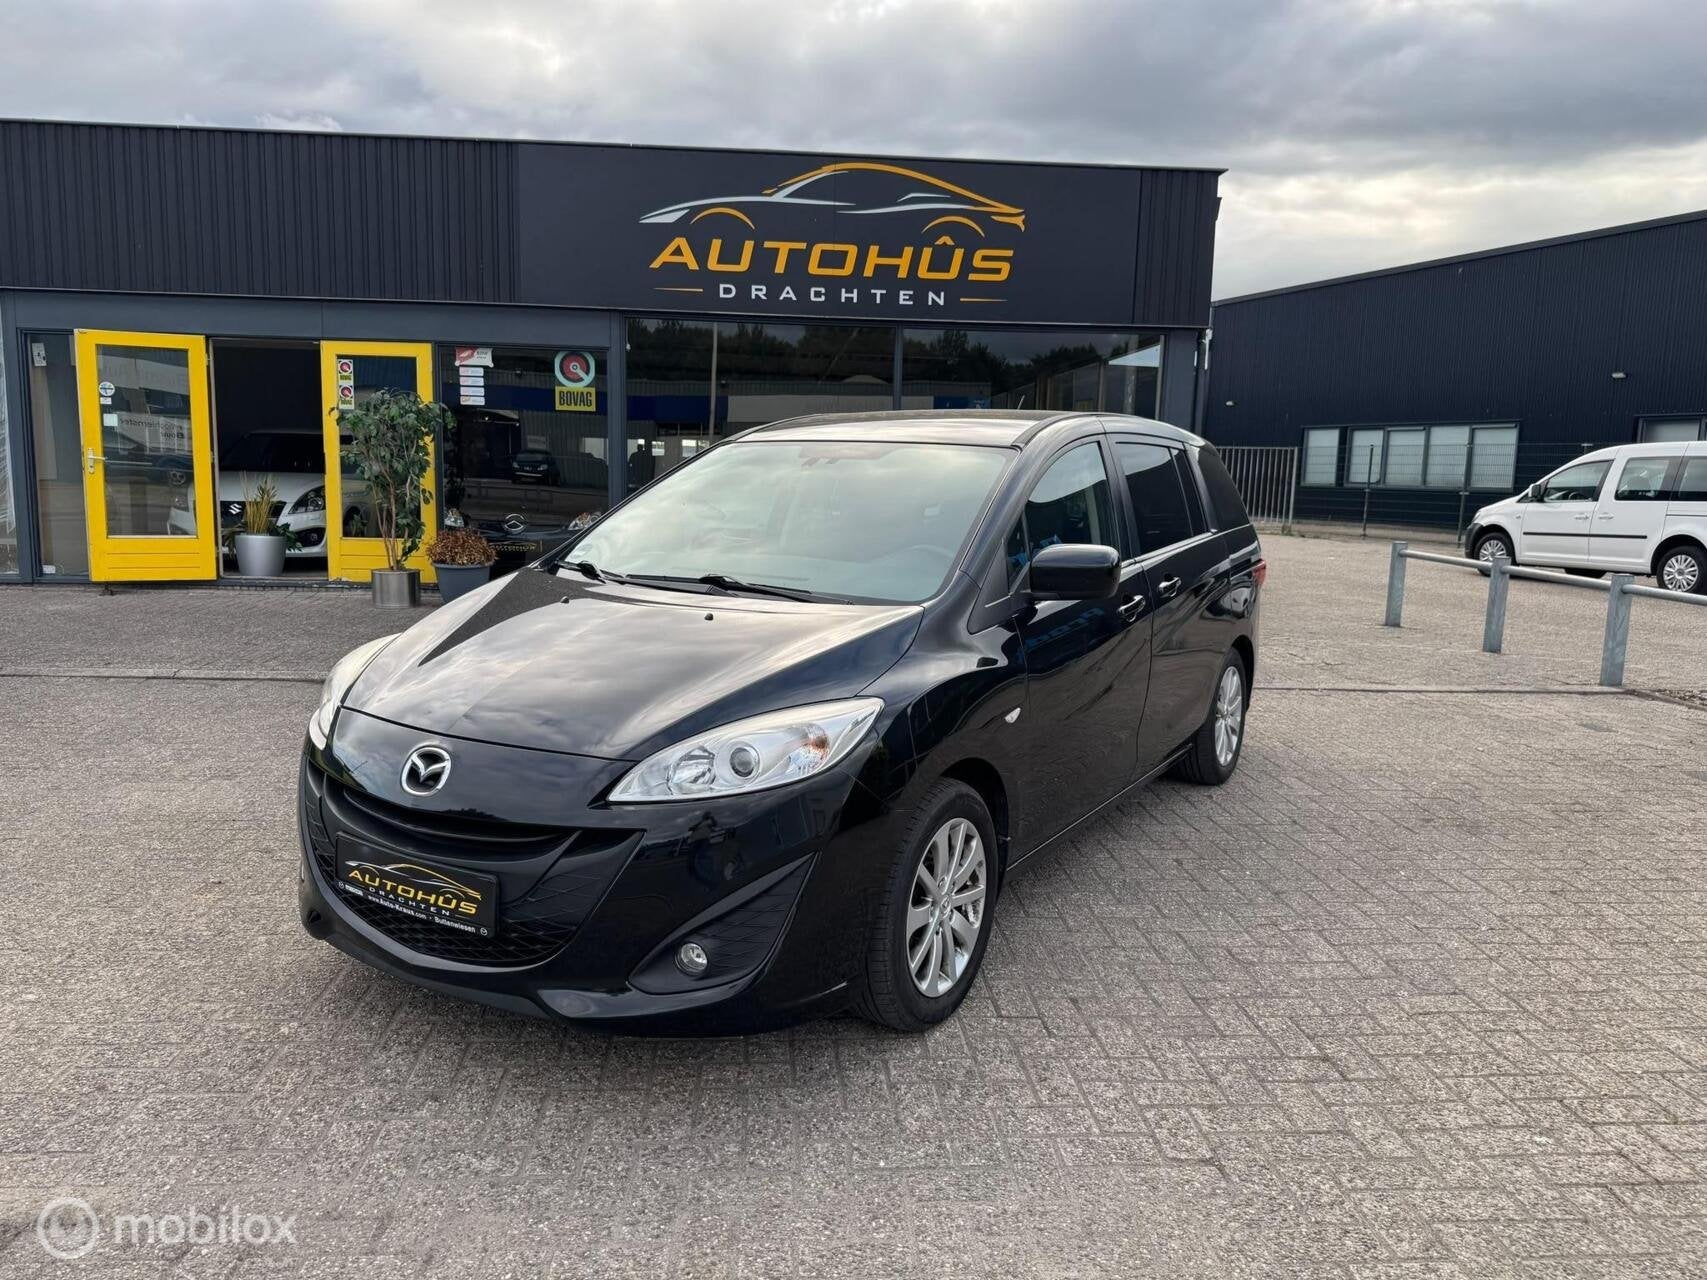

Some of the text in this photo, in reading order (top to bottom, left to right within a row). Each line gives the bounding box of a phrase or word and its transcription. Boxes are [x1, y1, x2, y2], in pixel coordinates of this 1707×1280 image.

[649, 236, 1014, 282] AUTOHÛS
[718, 284, 945, 306] DRACHTEN
[559, 390, 593, 408] BOVAG
[369, 886, 451, 916] DRACHTEN
